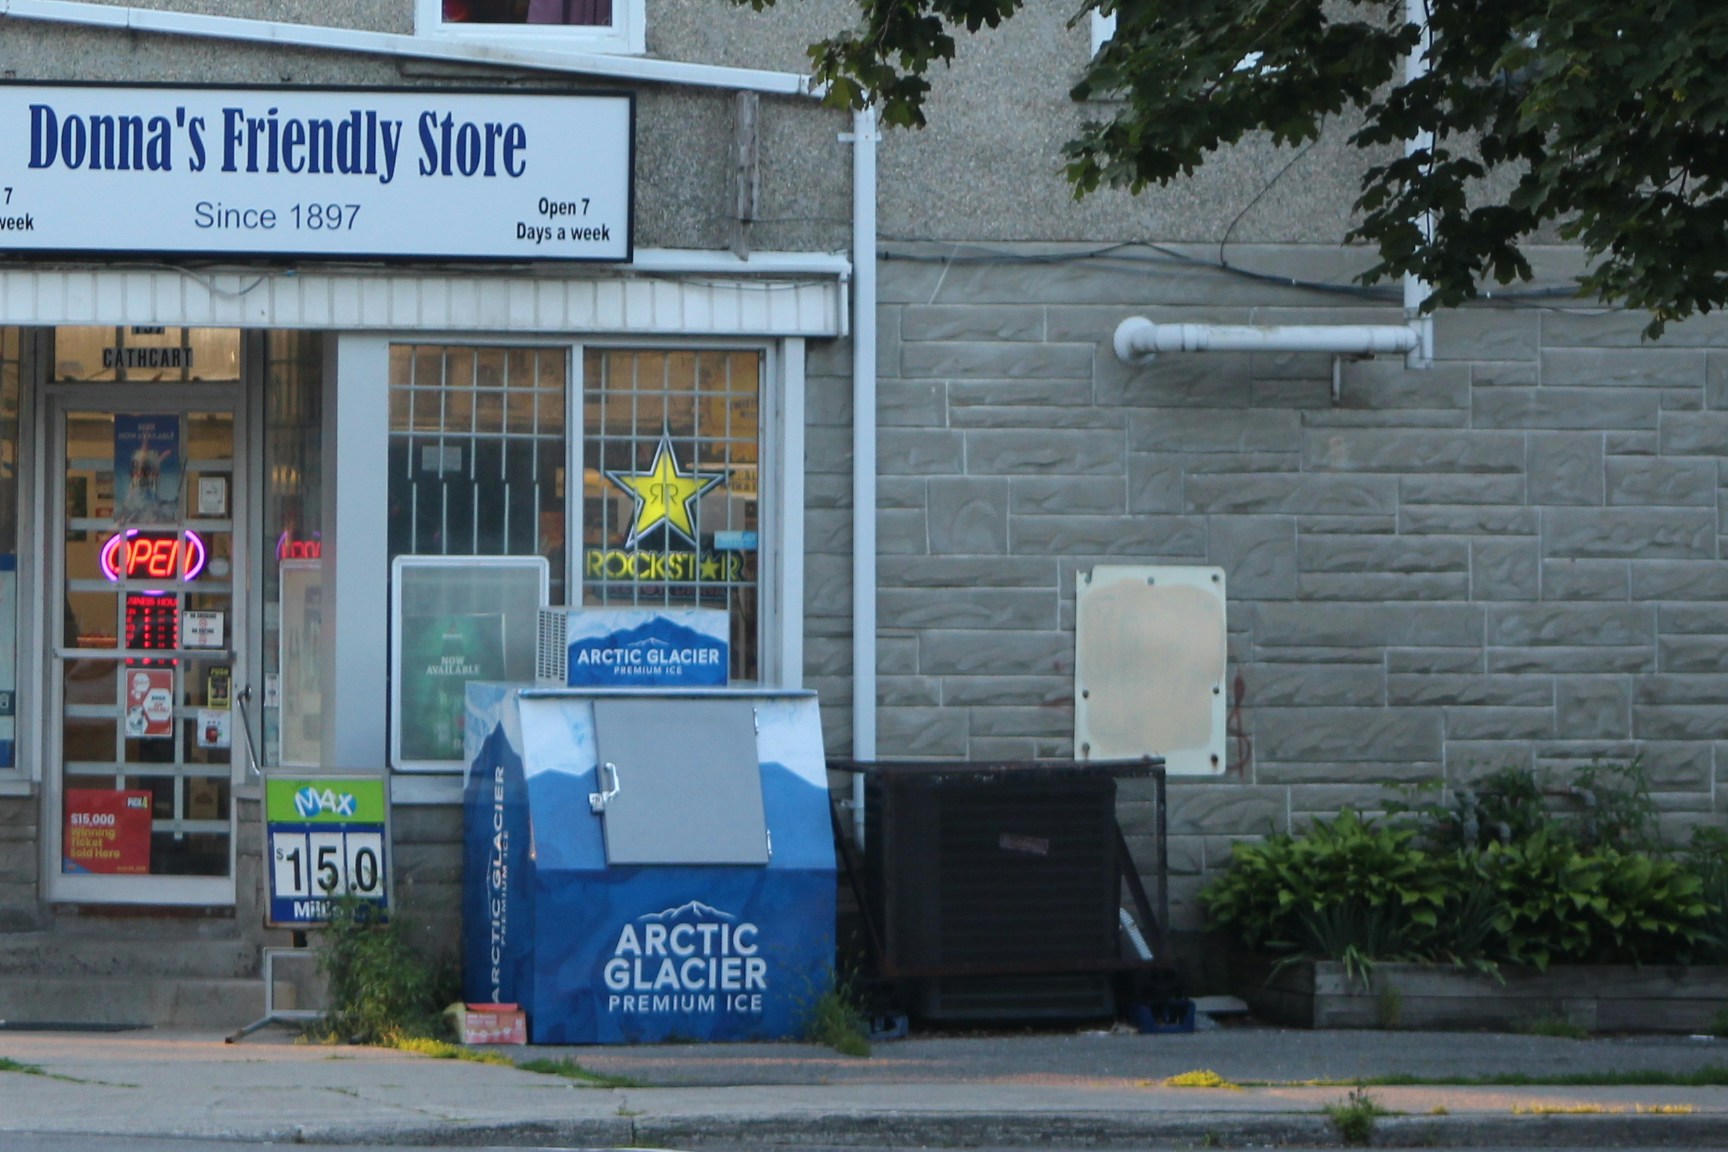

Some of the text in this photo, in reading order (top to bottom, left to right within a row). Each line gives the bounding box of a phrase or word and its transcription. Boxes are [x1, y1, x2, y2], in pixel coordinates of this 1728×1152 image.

[28, 104, 527, 184] Donna's Friendly Store
[4, 186, 13, 205] 7
[195, 201, 361, 231] Since 1897
[538, 197, 591, 219] Open 7
[516, 222, 610, 244] Days a week
[103, 348, 192, 368] CATHCART
[107, 538, 194, 577] OPEN
[441, 656, 465, 665] NOW
[578, 648, 720, 665] ARCTIC GLACIER
[426, 664, 480, 674] AVAILABLE
[613, 666, 683, 675] PREMIUM ICE
[71, 813, 116, 827] $15,000
[71, 826, 116, 840] Winning
[71, 837, 103, 848] Ticket
[71, 848, 121, 859] Sold Here
[490, 765, 505, 1003] ARCTIC GLACIER
[500, 863, 508, 946] PREMIUM
[614, 922, 759, 956] ARCTIC
[603, 957, 768, 990] GLACIER
[608, 994, 763, 1013] PREMIUM ICE
